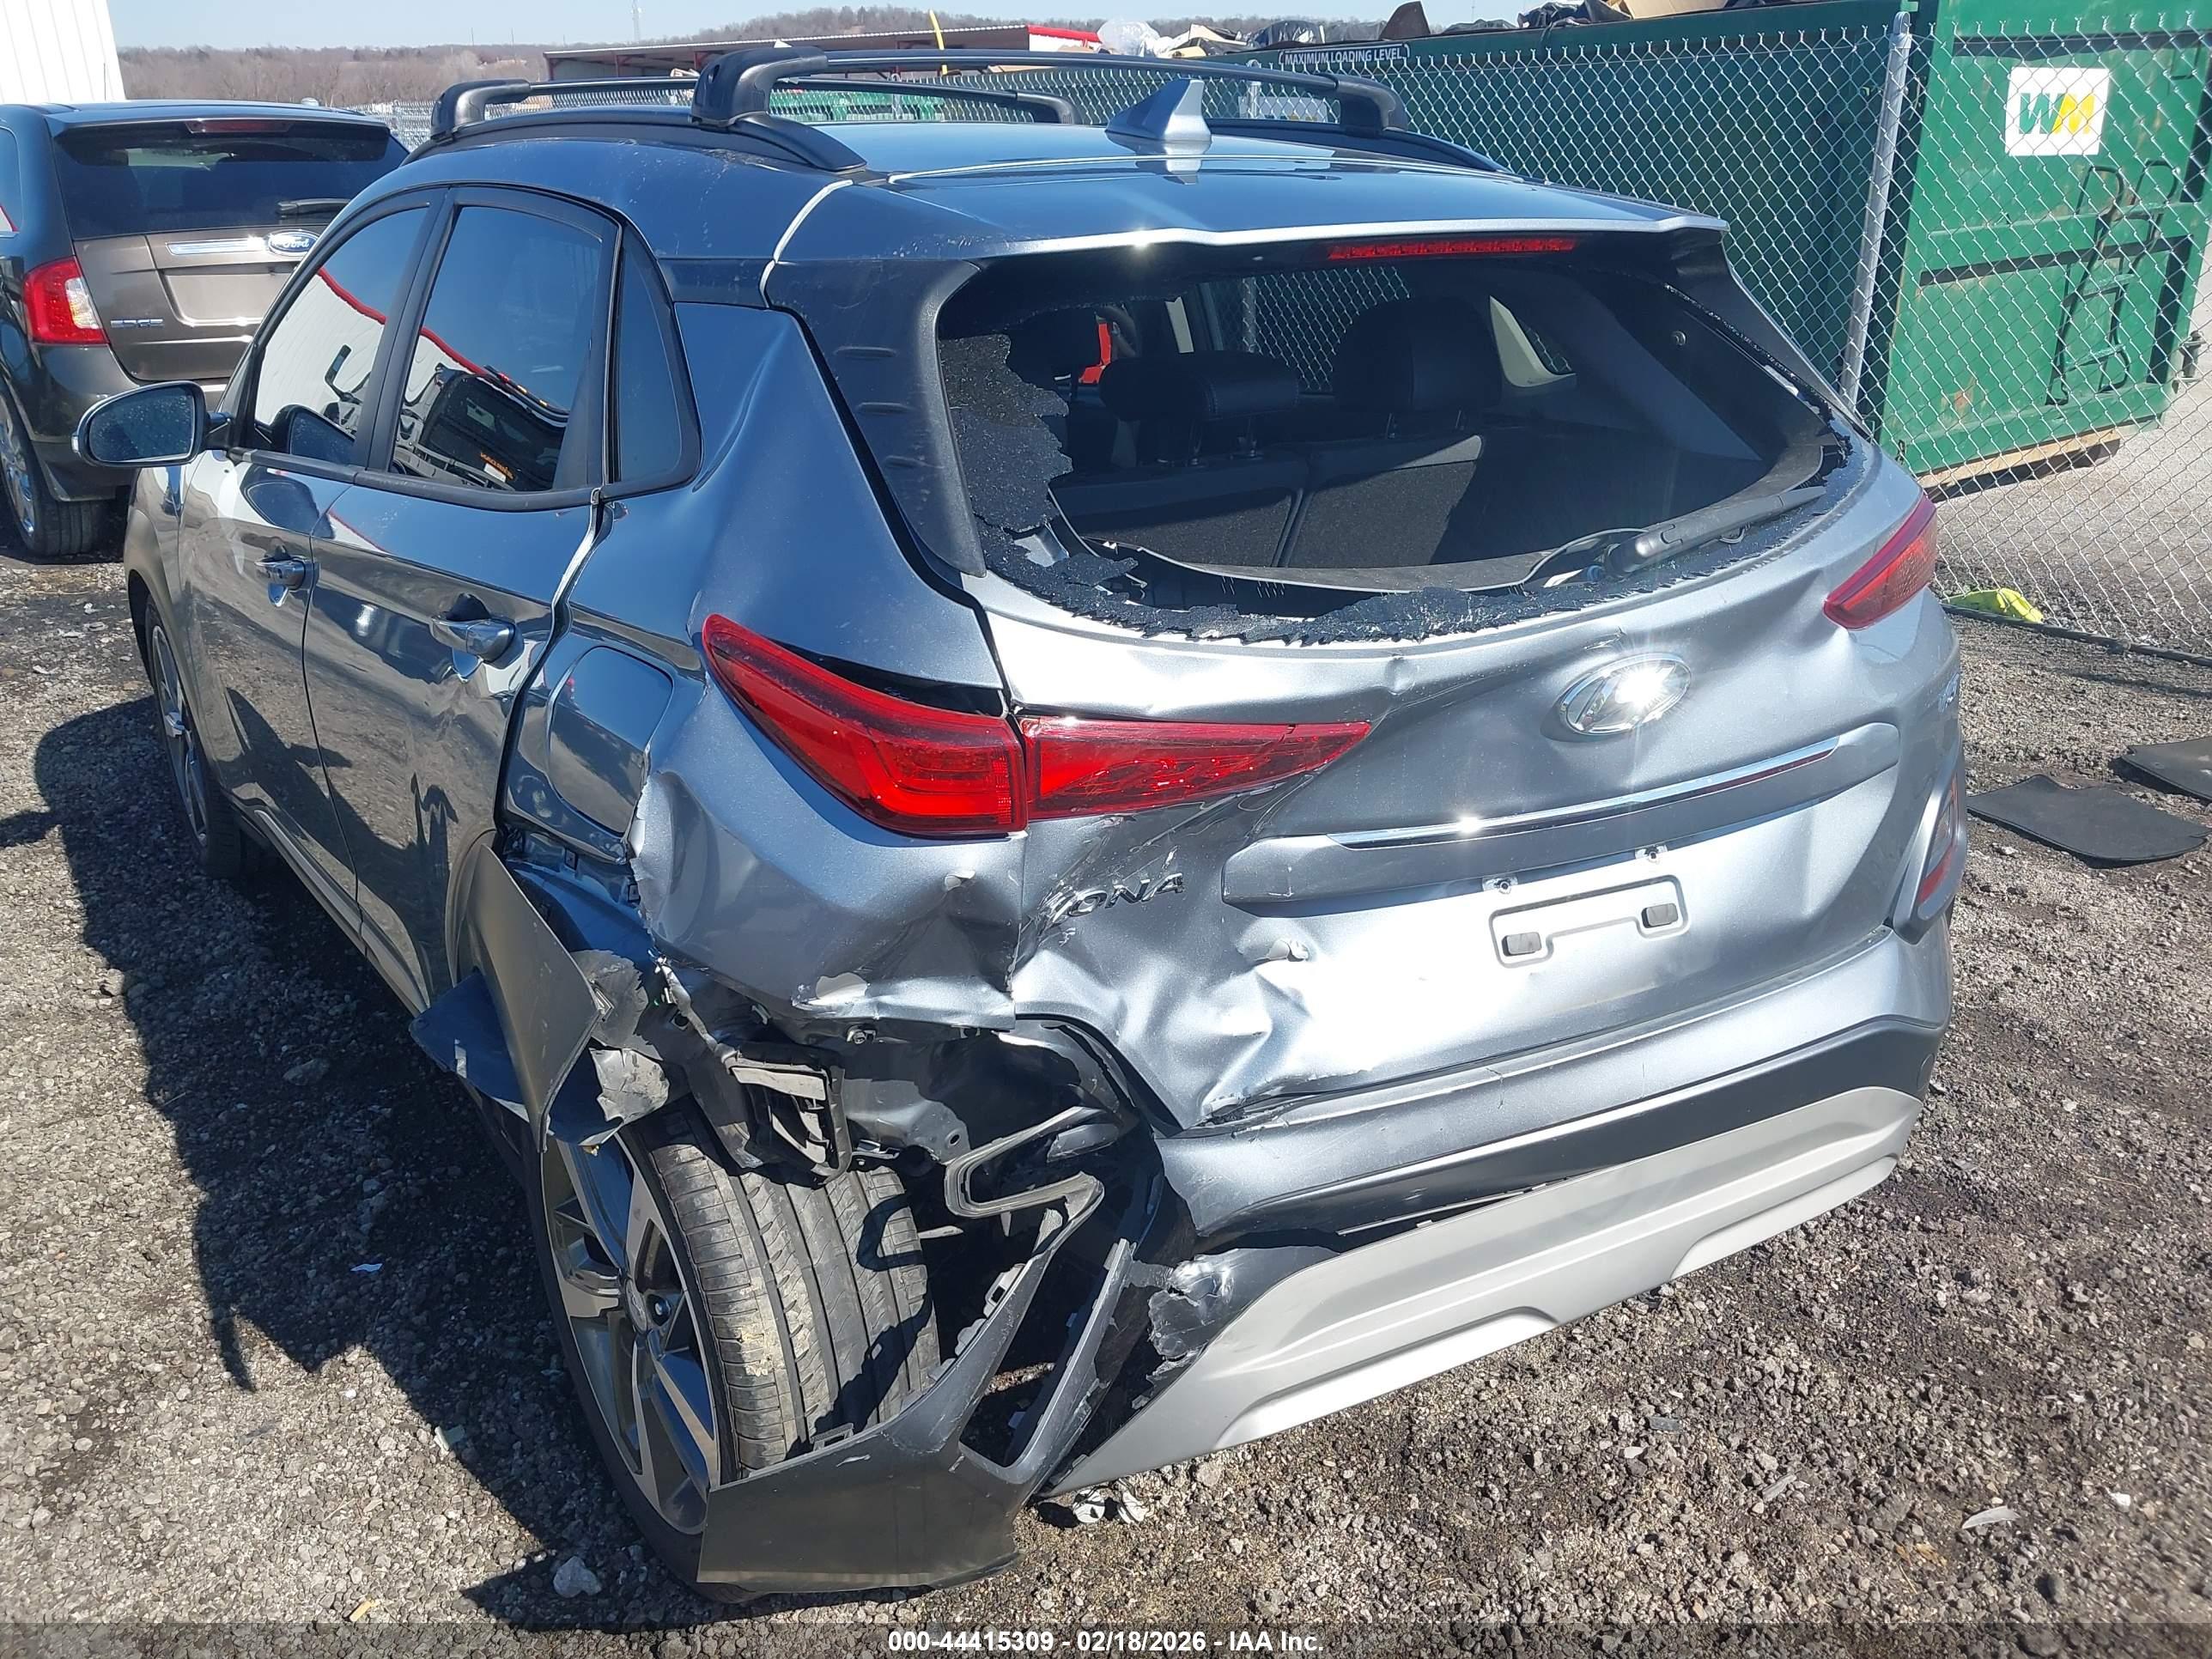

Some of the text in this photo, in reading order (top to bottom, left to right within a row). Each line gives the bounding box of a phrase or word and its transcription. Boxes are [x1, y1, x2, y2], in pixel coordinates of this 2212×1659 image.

[1285, 47, 1403, 65] MAXIMUM LOADING LEVEL
[2019, 92, 2095, 135] WM
